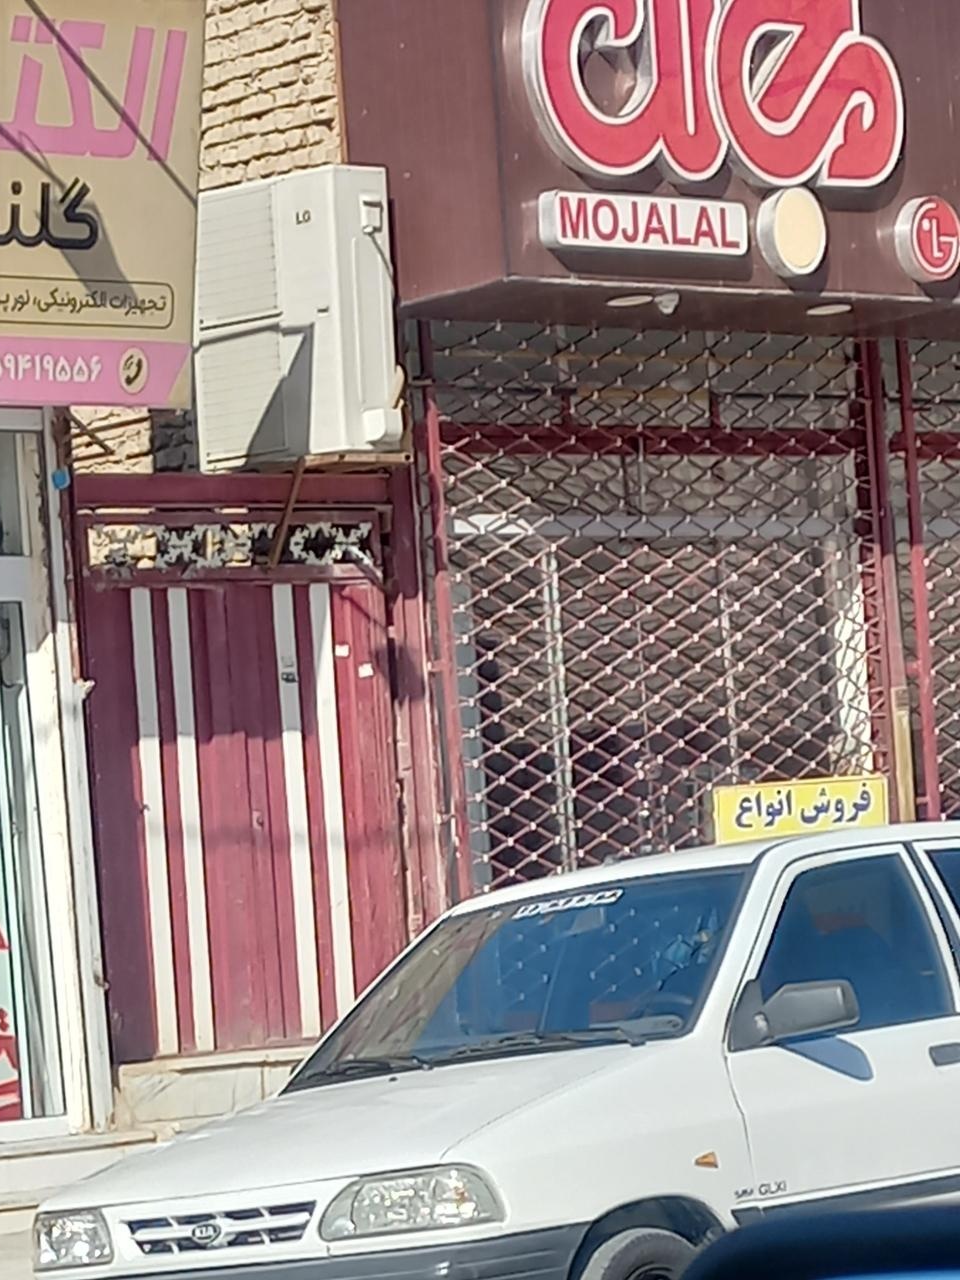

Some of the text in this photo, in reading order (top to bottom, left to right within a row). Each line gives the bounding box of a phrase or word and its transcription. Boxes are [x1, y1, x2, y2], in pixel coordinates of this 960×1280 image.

[558, 196, 741, 249] MOJALAL
[110, 286, 167, 313] تجهیزات
[734, 782, 872, 828] فروش انواع
